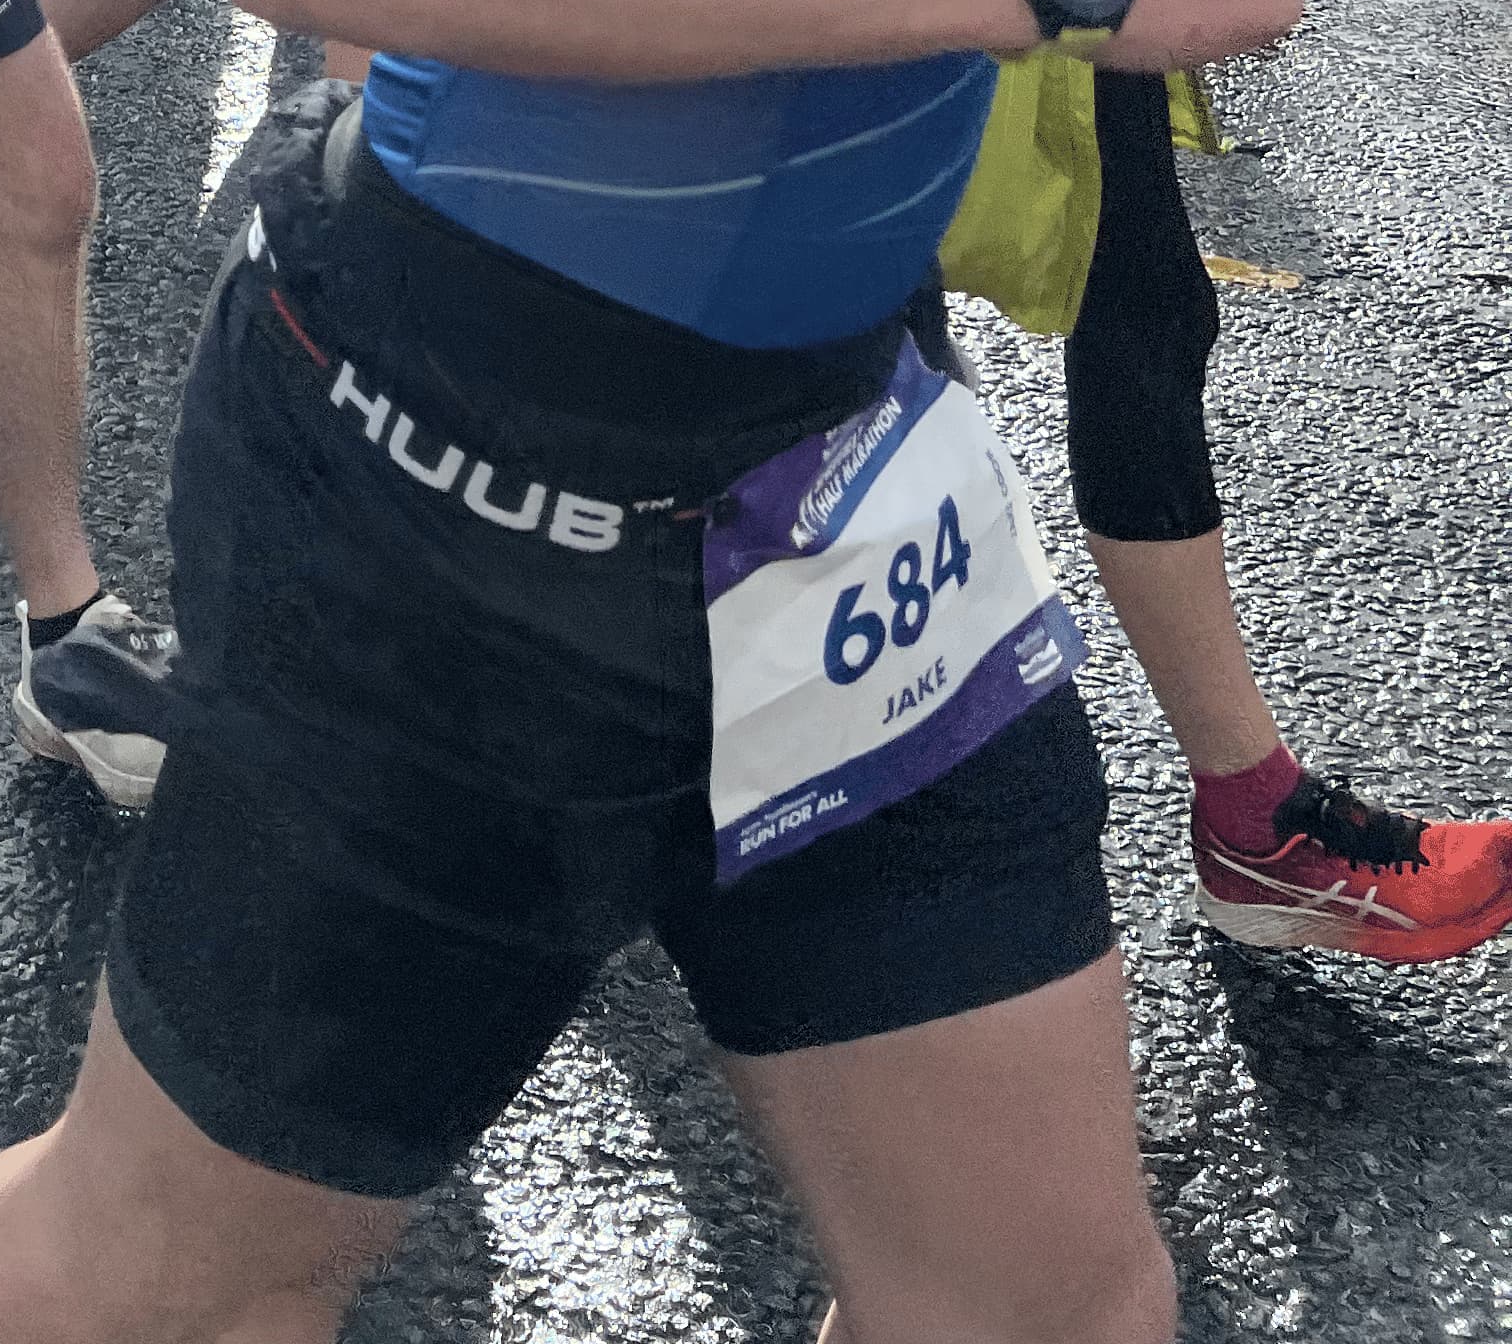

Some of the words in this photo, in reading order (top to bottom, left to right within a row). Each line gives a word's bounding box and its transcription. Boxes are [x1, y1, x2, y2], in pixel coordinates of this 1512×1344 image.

[330, 360, 624, 552] HUUB
[842, 395, 903, 486] MARATHON
[823, 493, 971, 685] 684
[882, 656, 947, 725] JAKE
[740, 823, 776, 856] RUN
[779, 804, 812, 834] FOR
[816, 788, 848, 814] ALL
